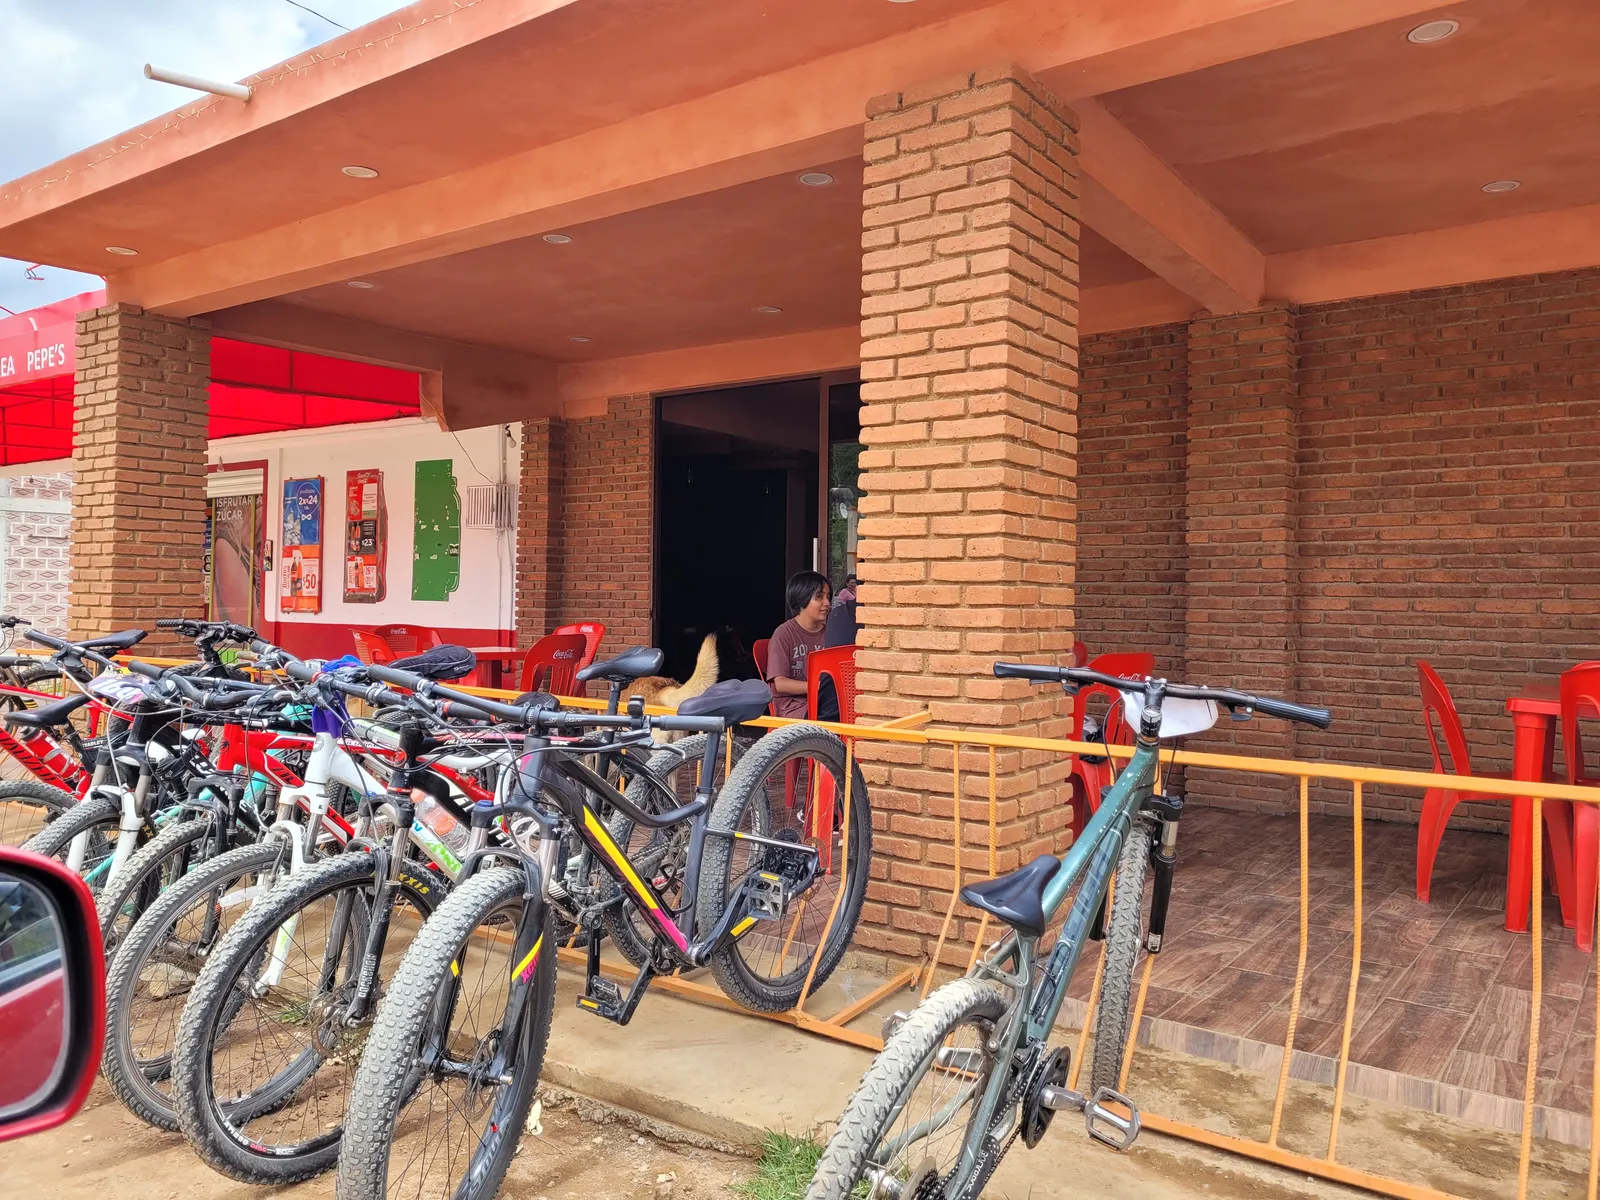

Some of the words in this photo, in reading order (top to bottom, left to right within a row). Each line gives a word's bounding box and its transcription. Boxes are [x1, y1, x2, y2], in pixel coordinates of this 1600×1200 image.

[27, 343, 65, 372] PEPE'S
[303, 573, 316, 589] $50
[398, 872, 430, 894] XXIS
